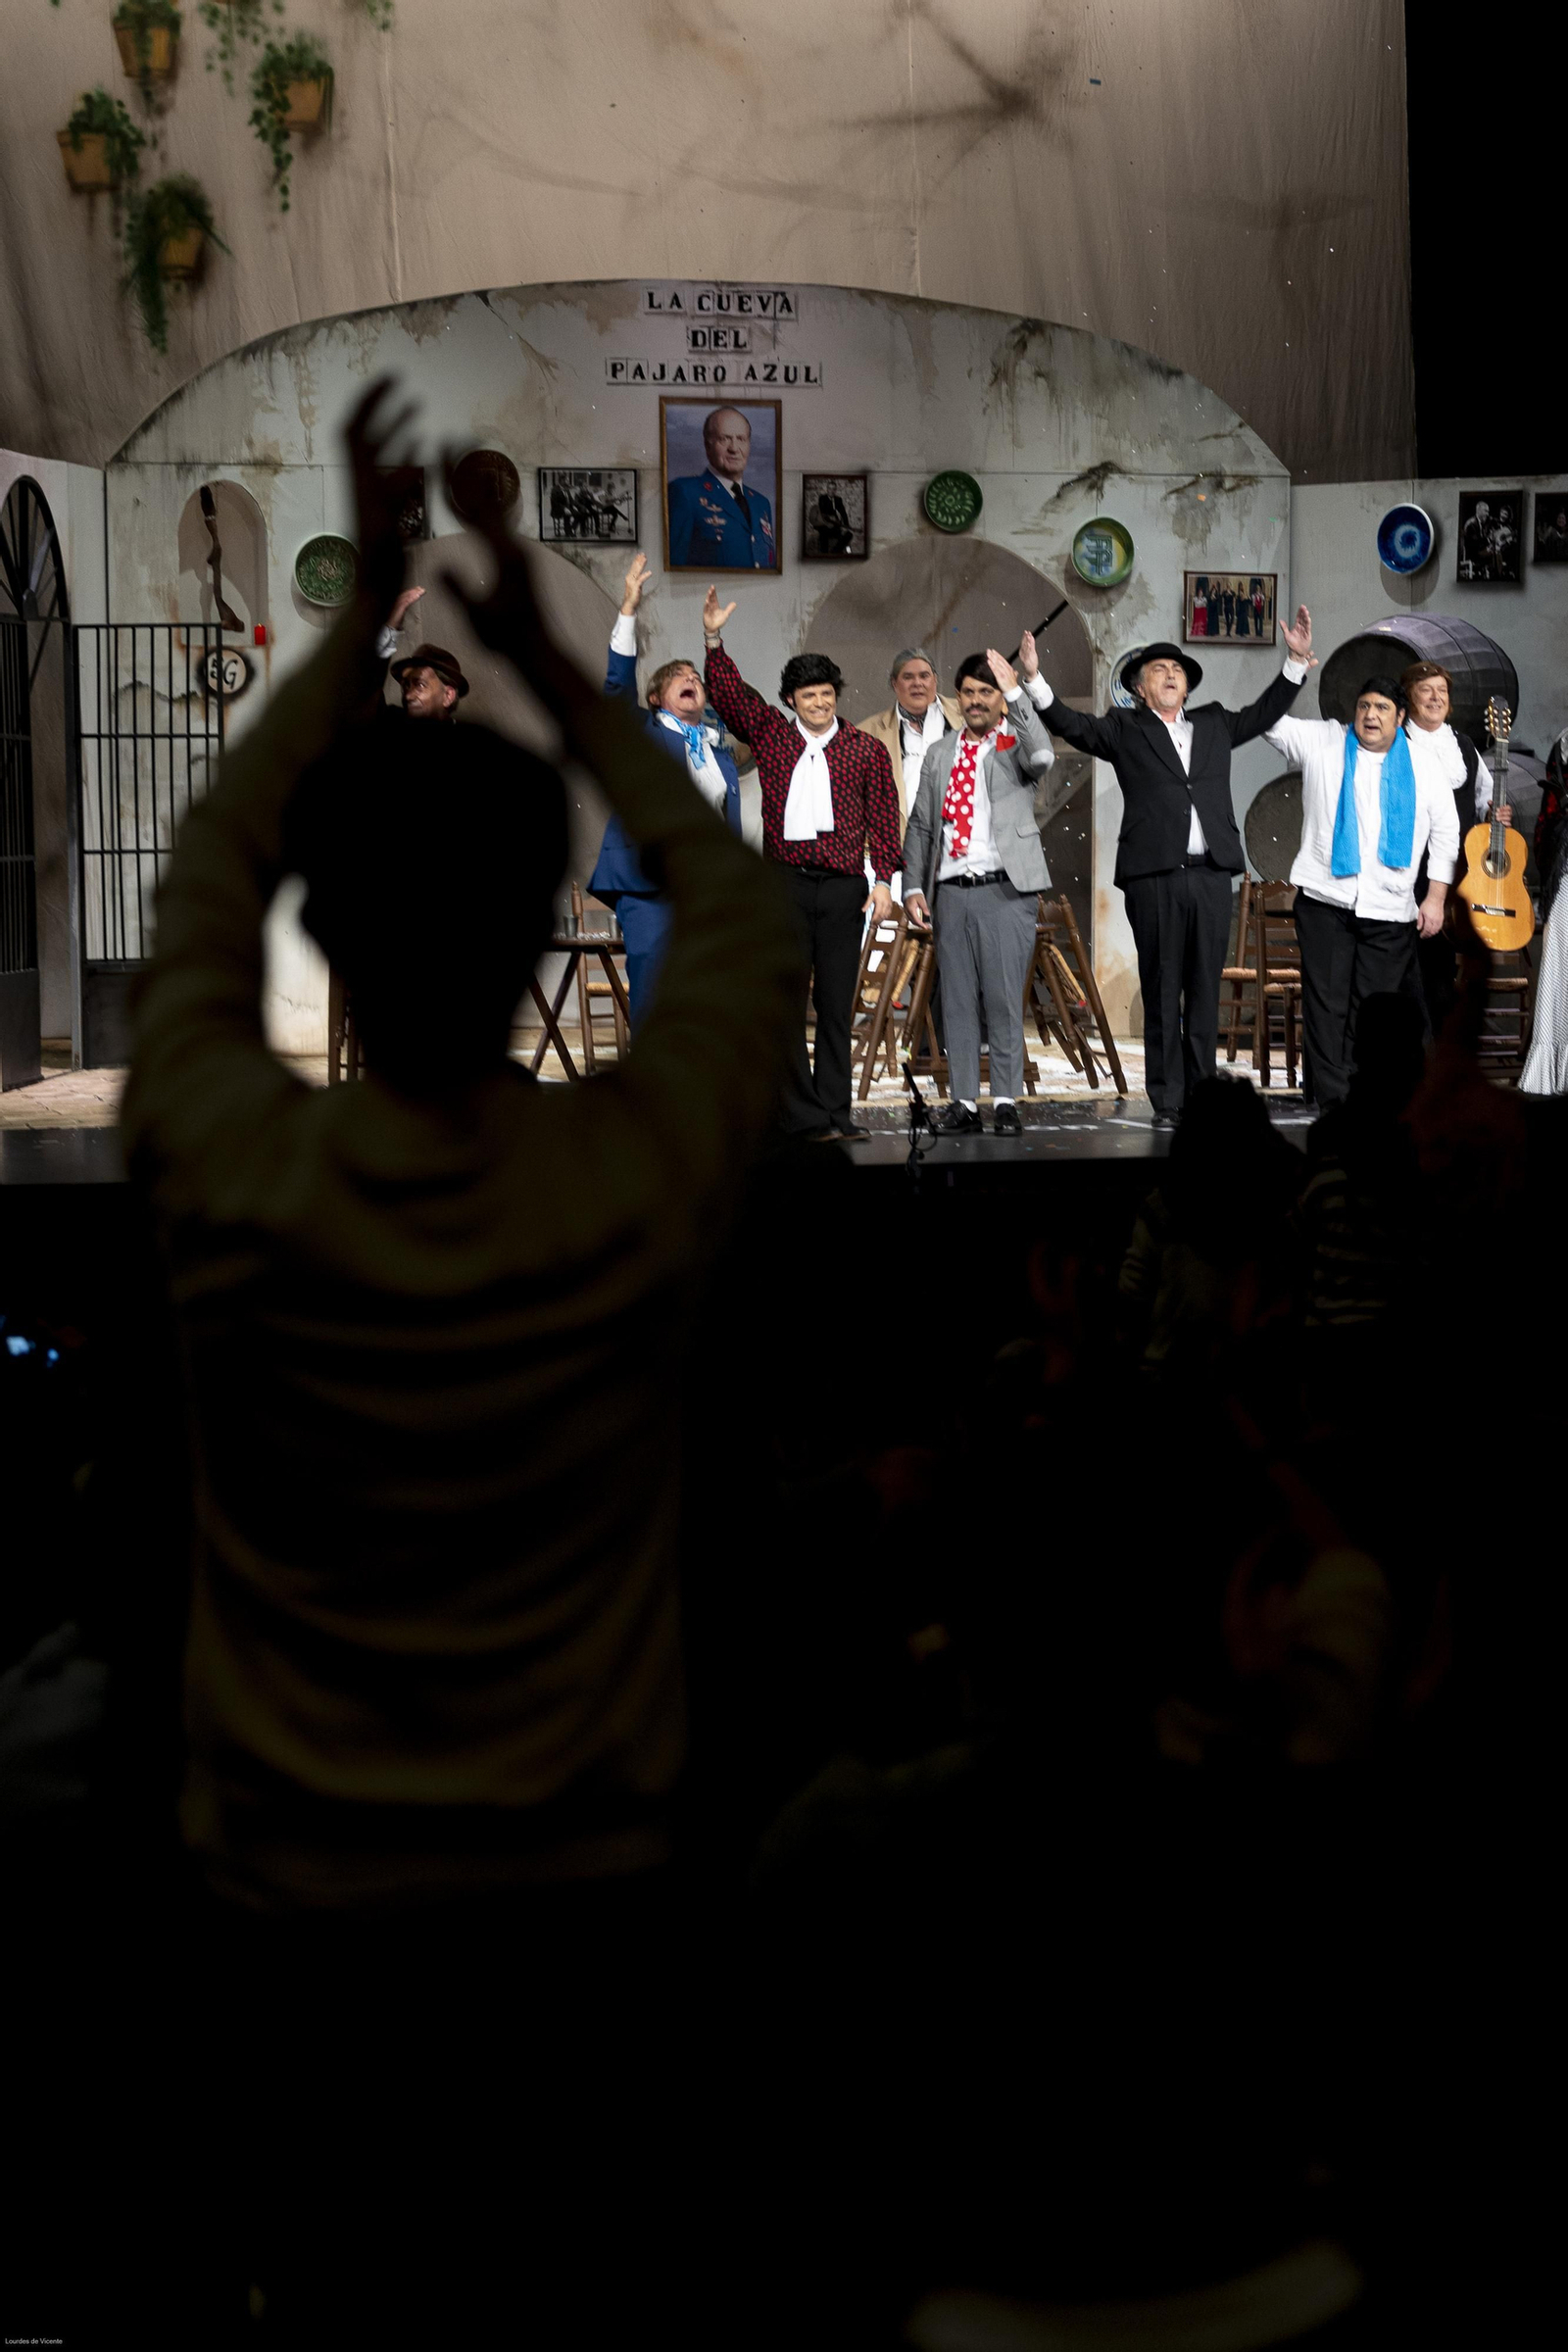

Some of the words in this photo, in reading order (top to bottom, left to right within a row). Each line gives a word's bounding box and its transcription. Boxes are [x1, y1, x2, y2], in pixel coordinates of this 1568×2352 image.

[647, 292, 683, 310] LA
[697, 292, 794, 314] CUEVA
[691, 329, 748, 349] DEL
[611, 363, 727, 383] PAJARO
[744, 363, 818, 384] AZUL
